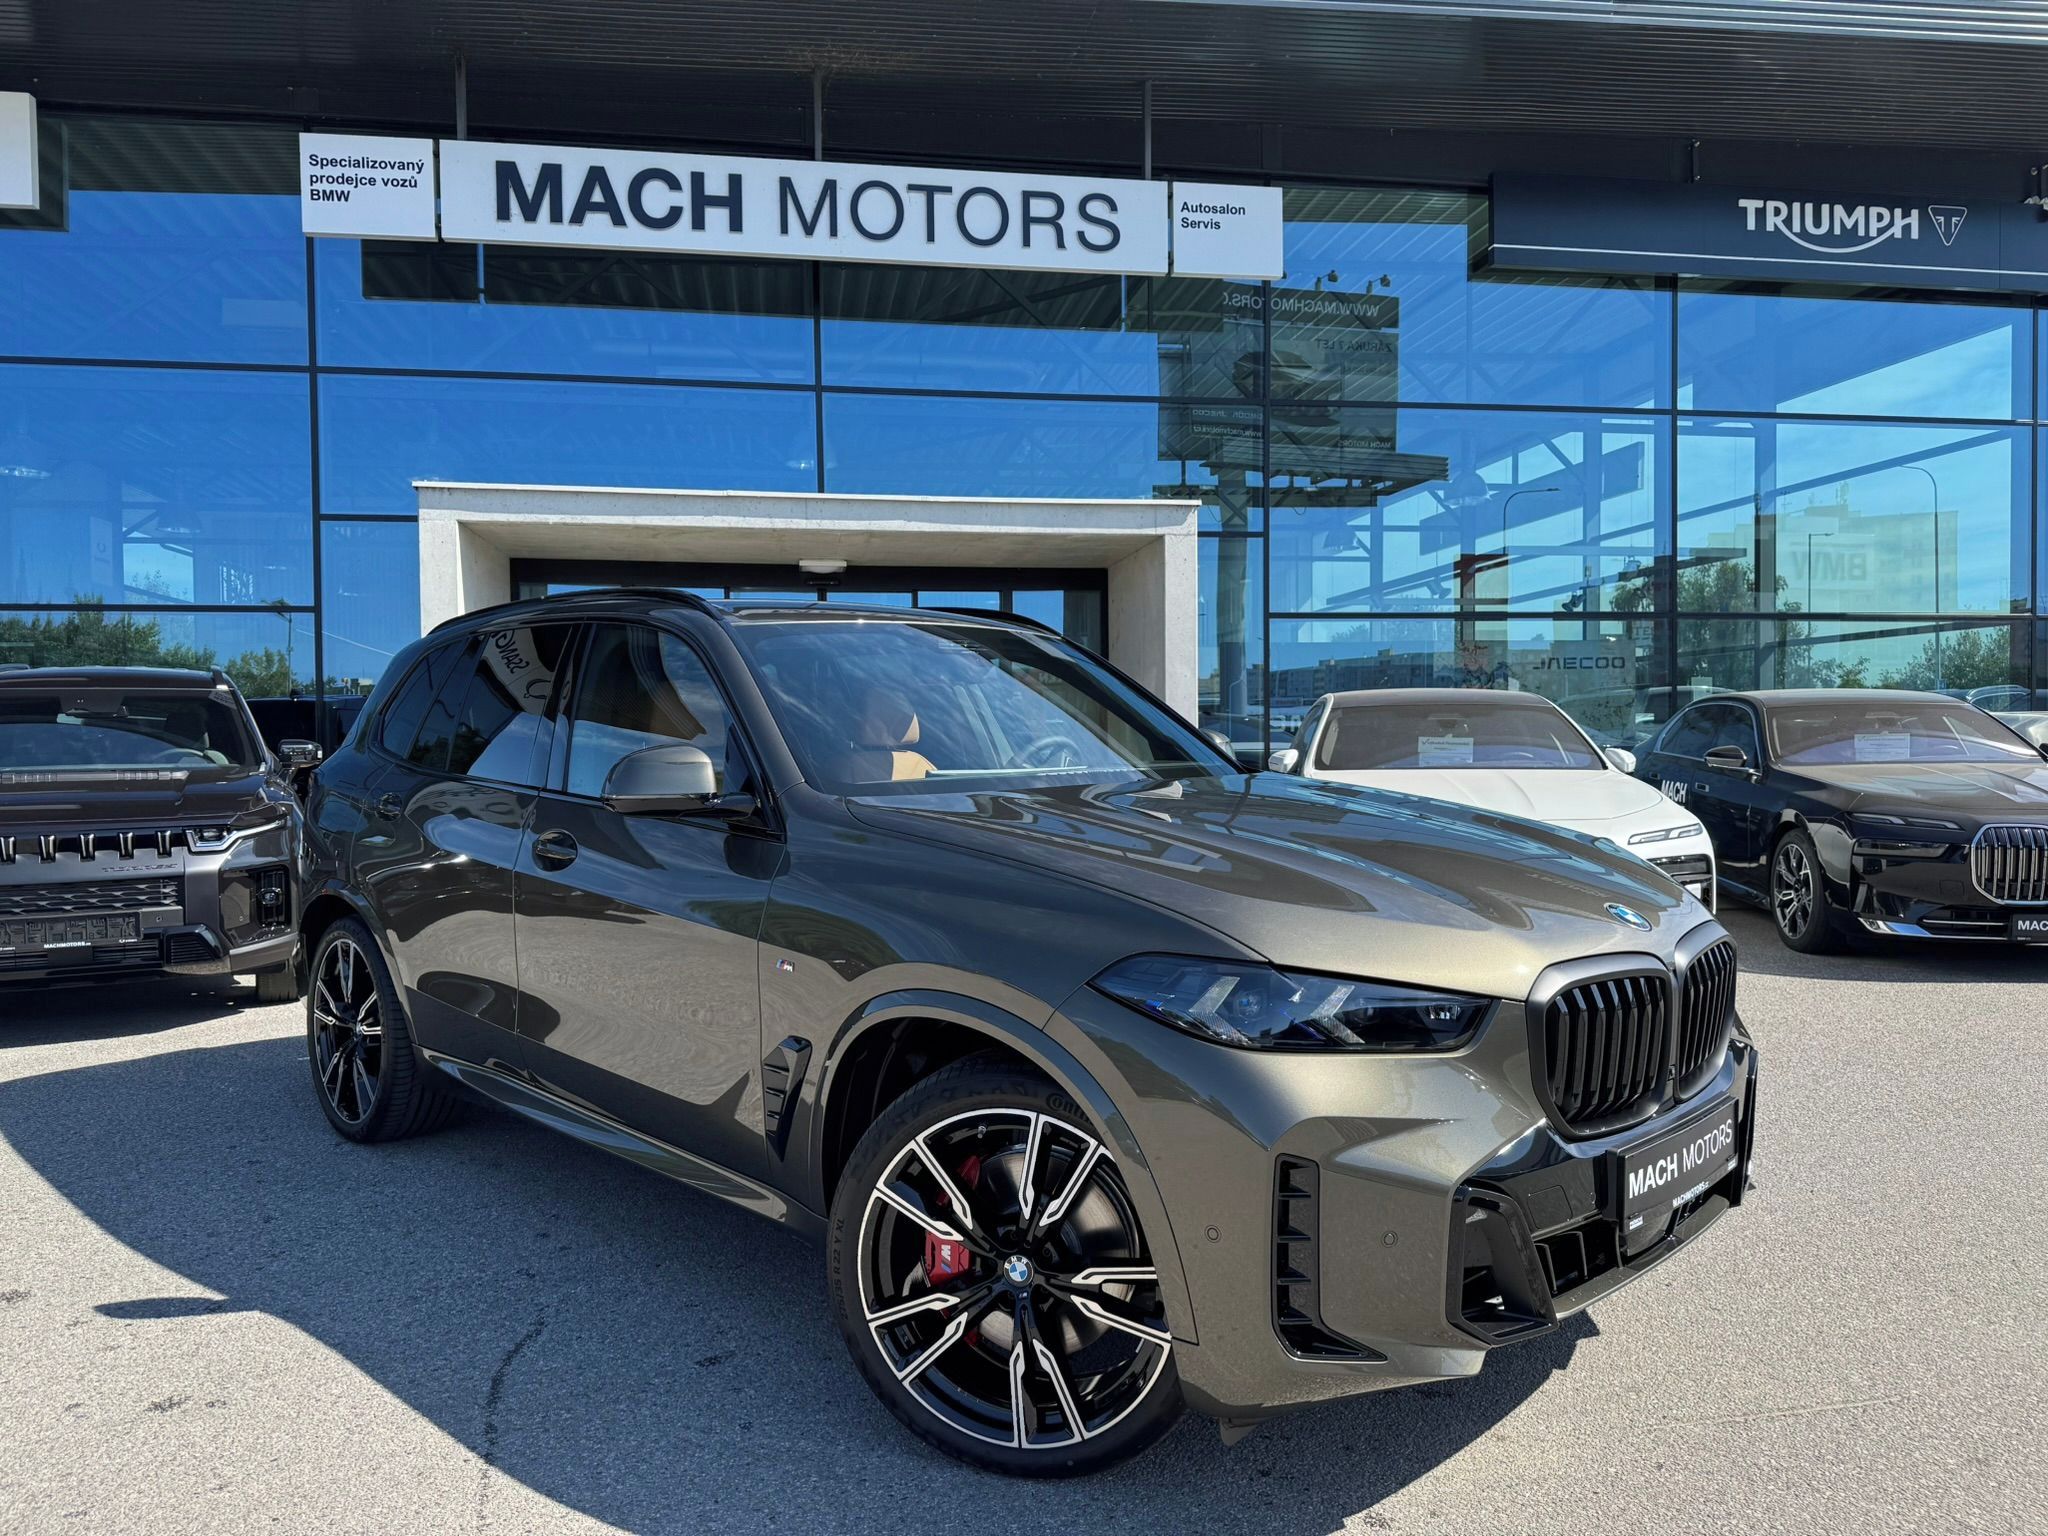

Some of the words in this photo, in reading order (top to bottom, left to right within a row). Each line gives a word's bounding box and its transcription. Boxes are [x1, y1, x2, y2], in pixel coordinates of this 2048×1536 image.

[308, 154, 424, 174] Specializovaný
[310, 173, 376, 188] prodejce
[381, 176, 418, 188] vozů
[310, 189, 350, 202] BMW
[496, 160, 742, 232] MACH
[778, 176, 1121, 252] MOTORS
[1180, 201, 1246, 215] Autosalon
[1181, 217, 1221, 230] Servis
[1738, 198, 1919, 252] TRIUMPH
[1532, 656, 1626, 669] JAECOO
[1661, 780, 1688, 803] MACH
[1629, 1153, 1678, 1199] MACH
[1683, 1118, 1732, 1173] MOTORS
